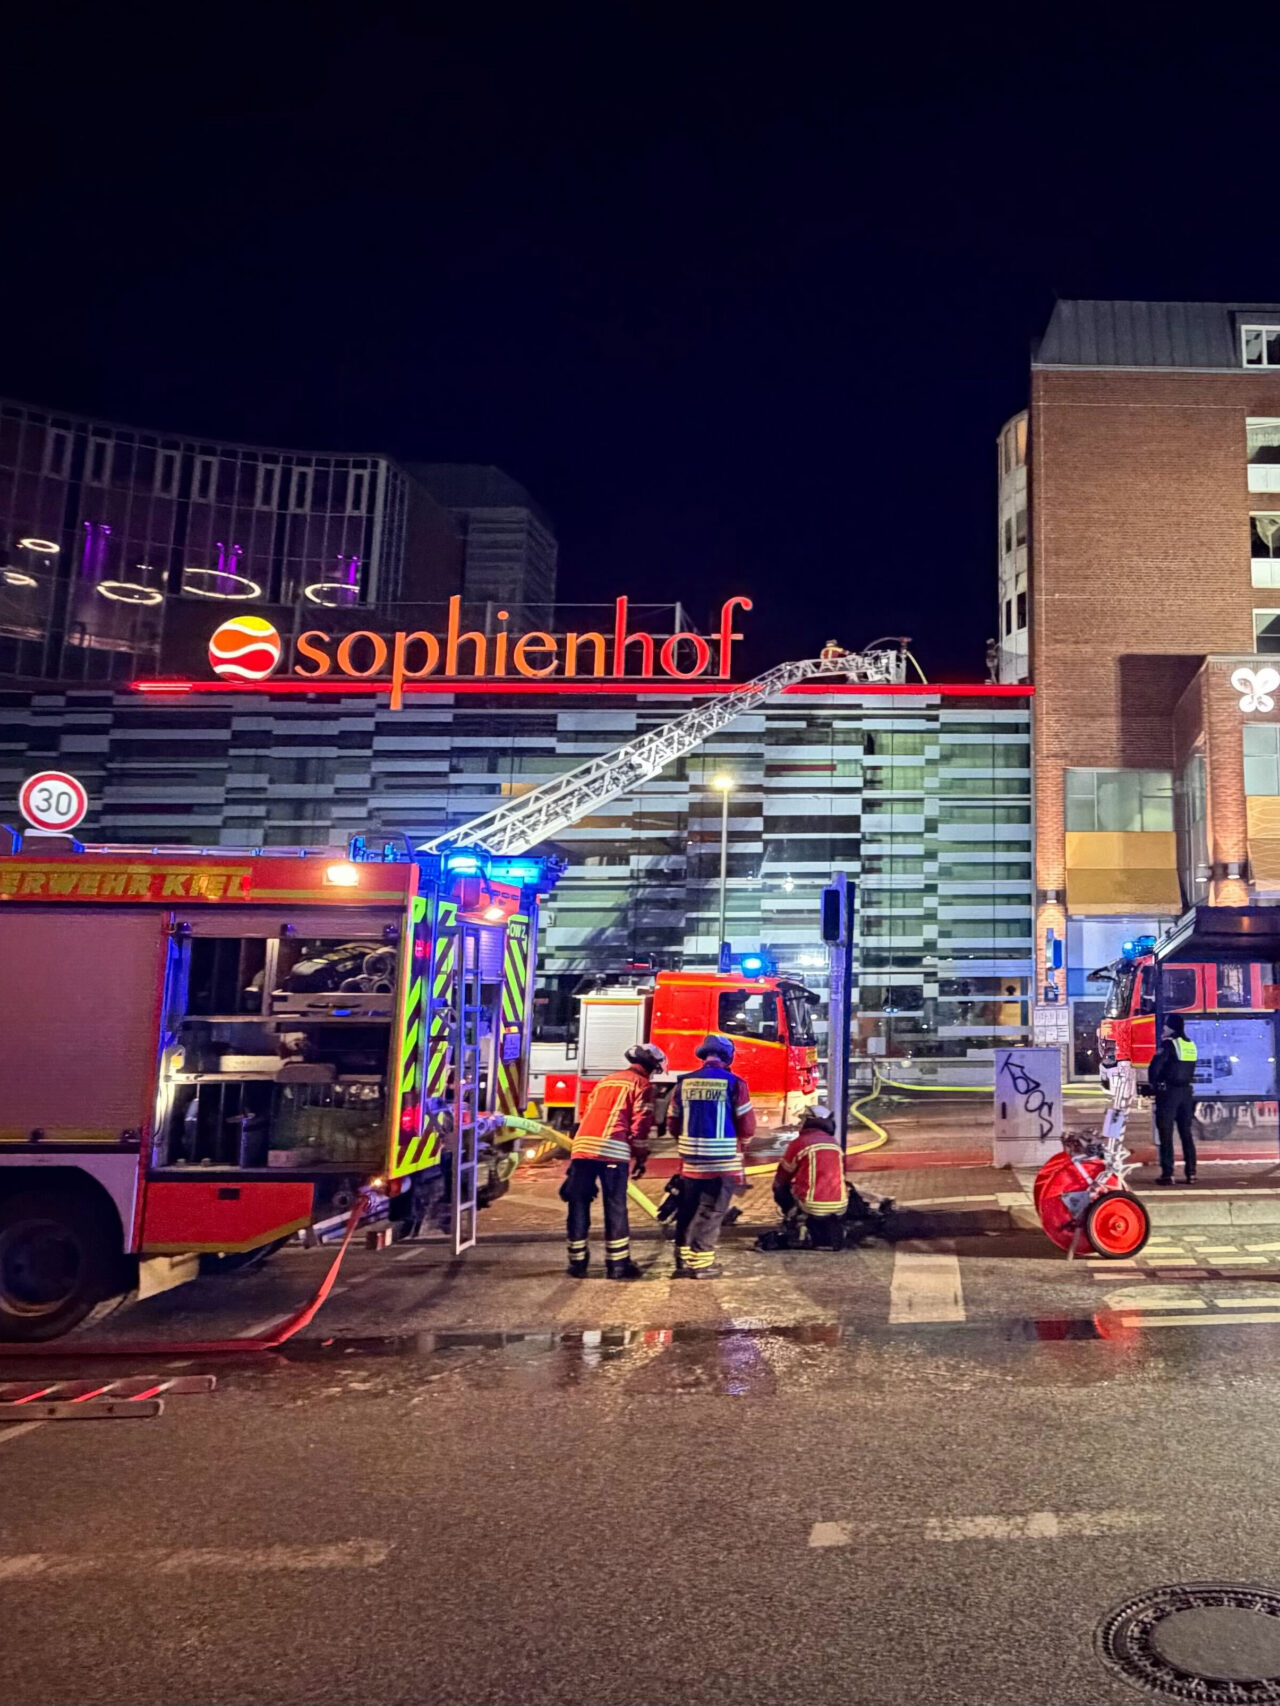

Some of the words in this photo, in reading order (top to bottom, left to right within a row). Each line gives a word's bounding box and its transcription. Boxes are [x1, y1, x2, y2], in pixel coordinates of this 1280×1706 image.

[294, 595, 752, 711] sophienhof
[35, 788, 72, 816] 30
[162, 874, 249, 897] KIEL
